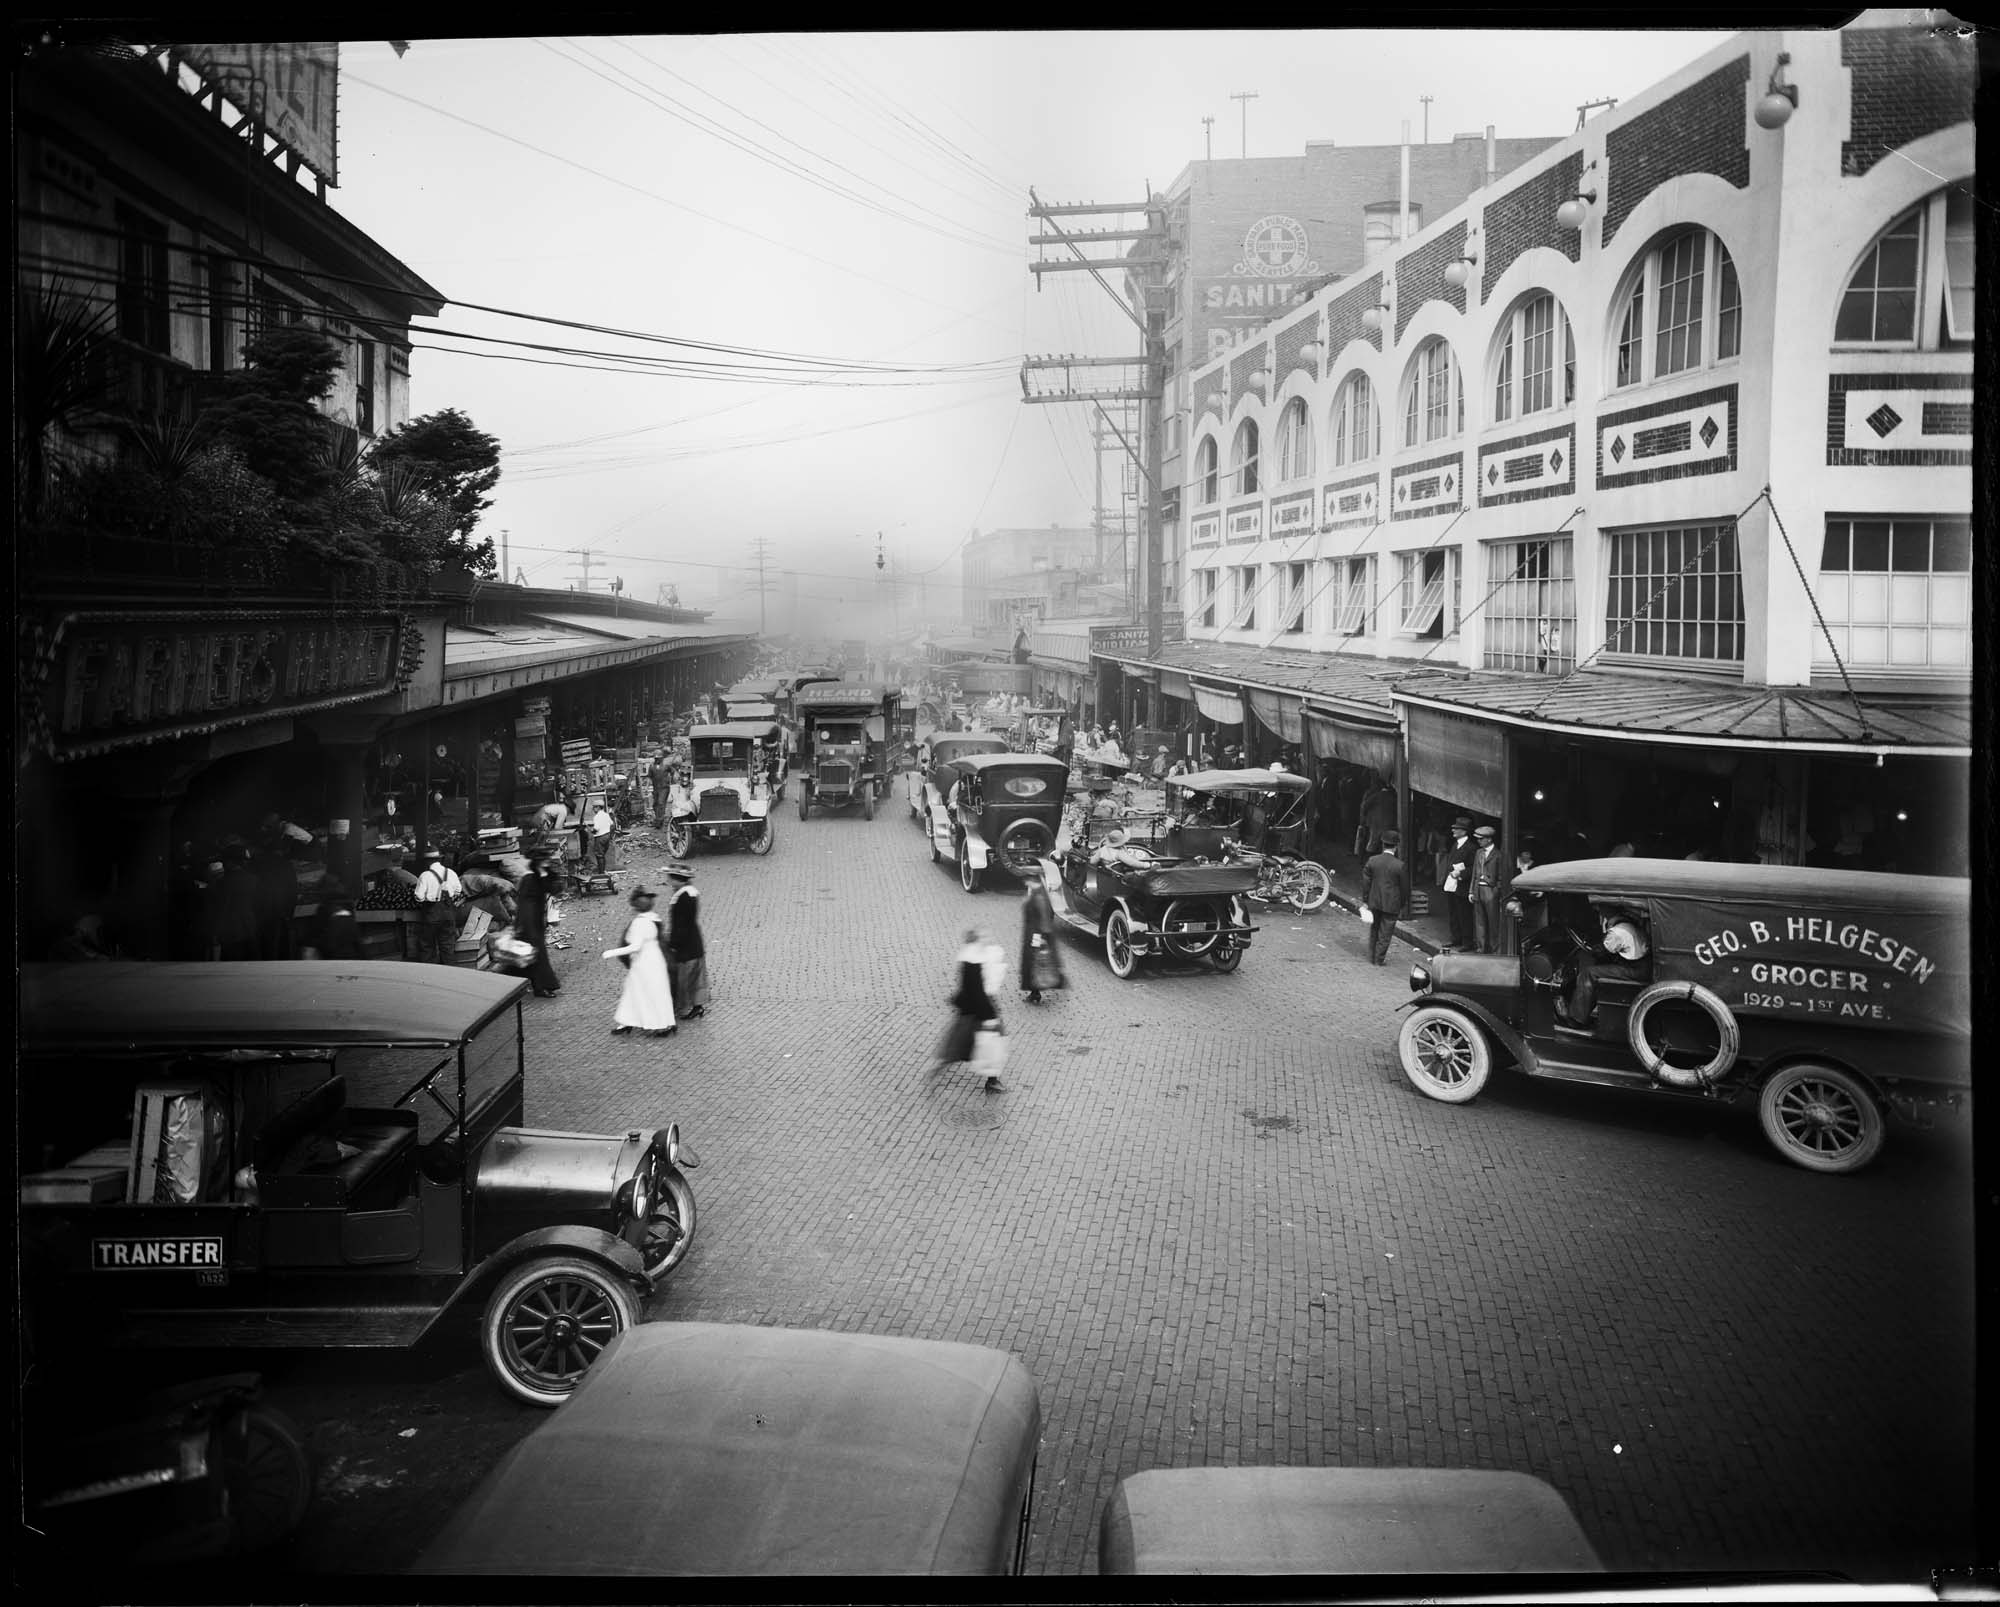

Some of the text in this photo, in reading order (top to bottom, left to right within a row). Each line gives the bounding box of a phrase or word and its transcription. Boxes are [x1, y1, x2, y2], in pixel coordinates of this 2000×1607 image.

[1207, 284, 1305, 308] SANIT
[1110, 630, 1149, 640] SANITA
[1694, 917, 1936, 985] GEO. B. HELGESEN
[1751, 963, 1869, 993] GROCER
[1743, 992, 1784, 1009] 1929
[1840, 1002, 1891, 1020] AVE.
[98, 1242, 219, 1265] TRANSFER
